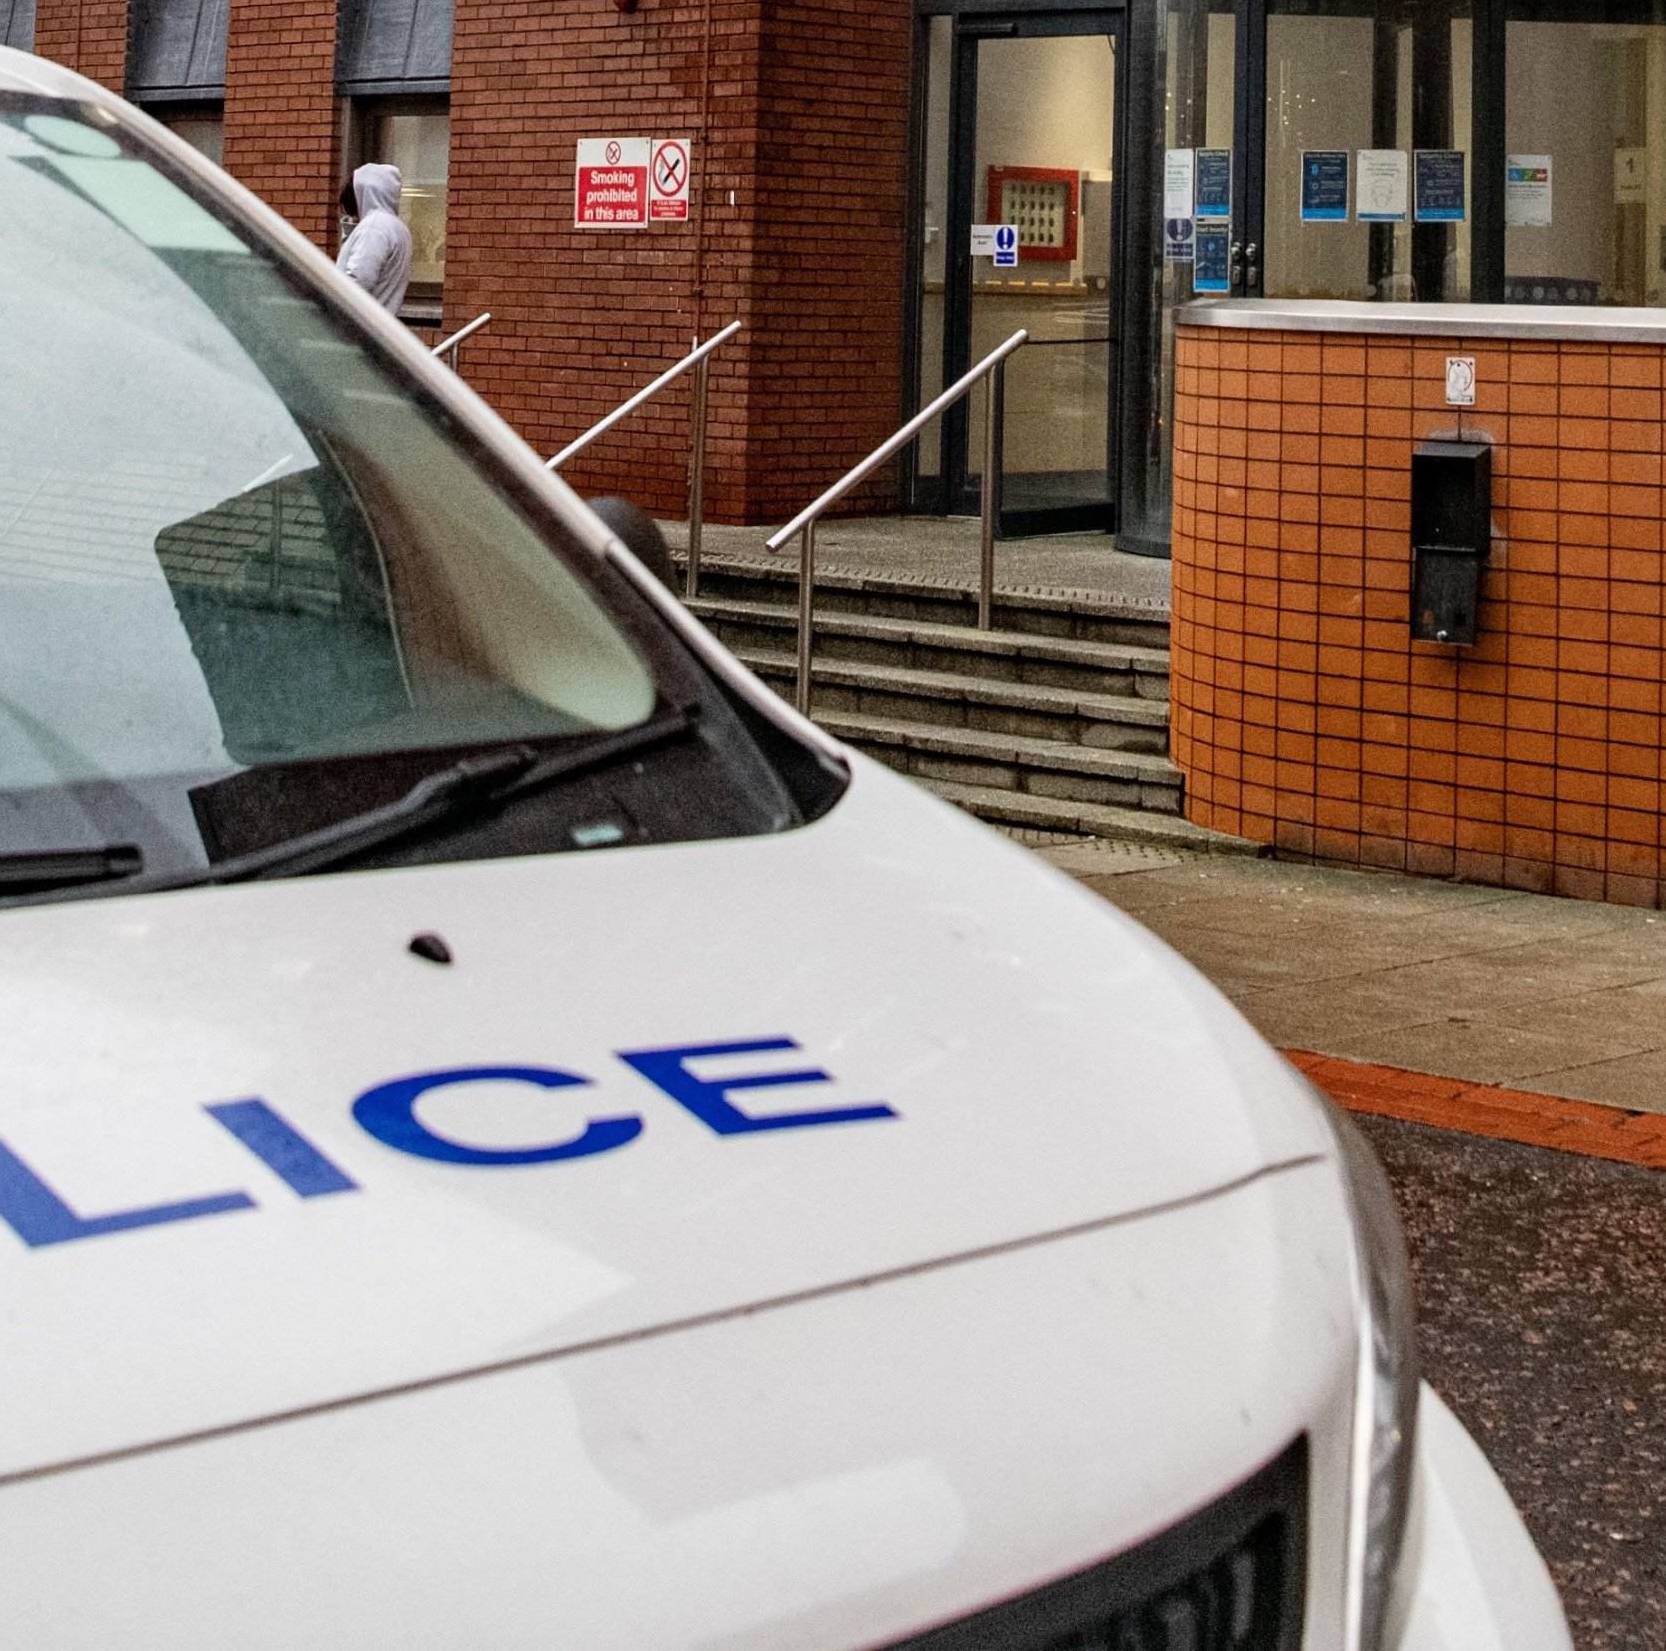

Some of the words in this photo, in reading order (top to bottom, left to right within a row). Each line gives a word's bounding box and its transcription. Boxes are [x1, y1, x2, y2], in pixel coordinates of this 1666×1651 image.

[590, 171, 635, 187] Smoking
[586, 188, 638, 205] prohibited
[584, 207, 594, 220] in
[595, 206, 614, 220] this
[616, 209, 639, 220] area
